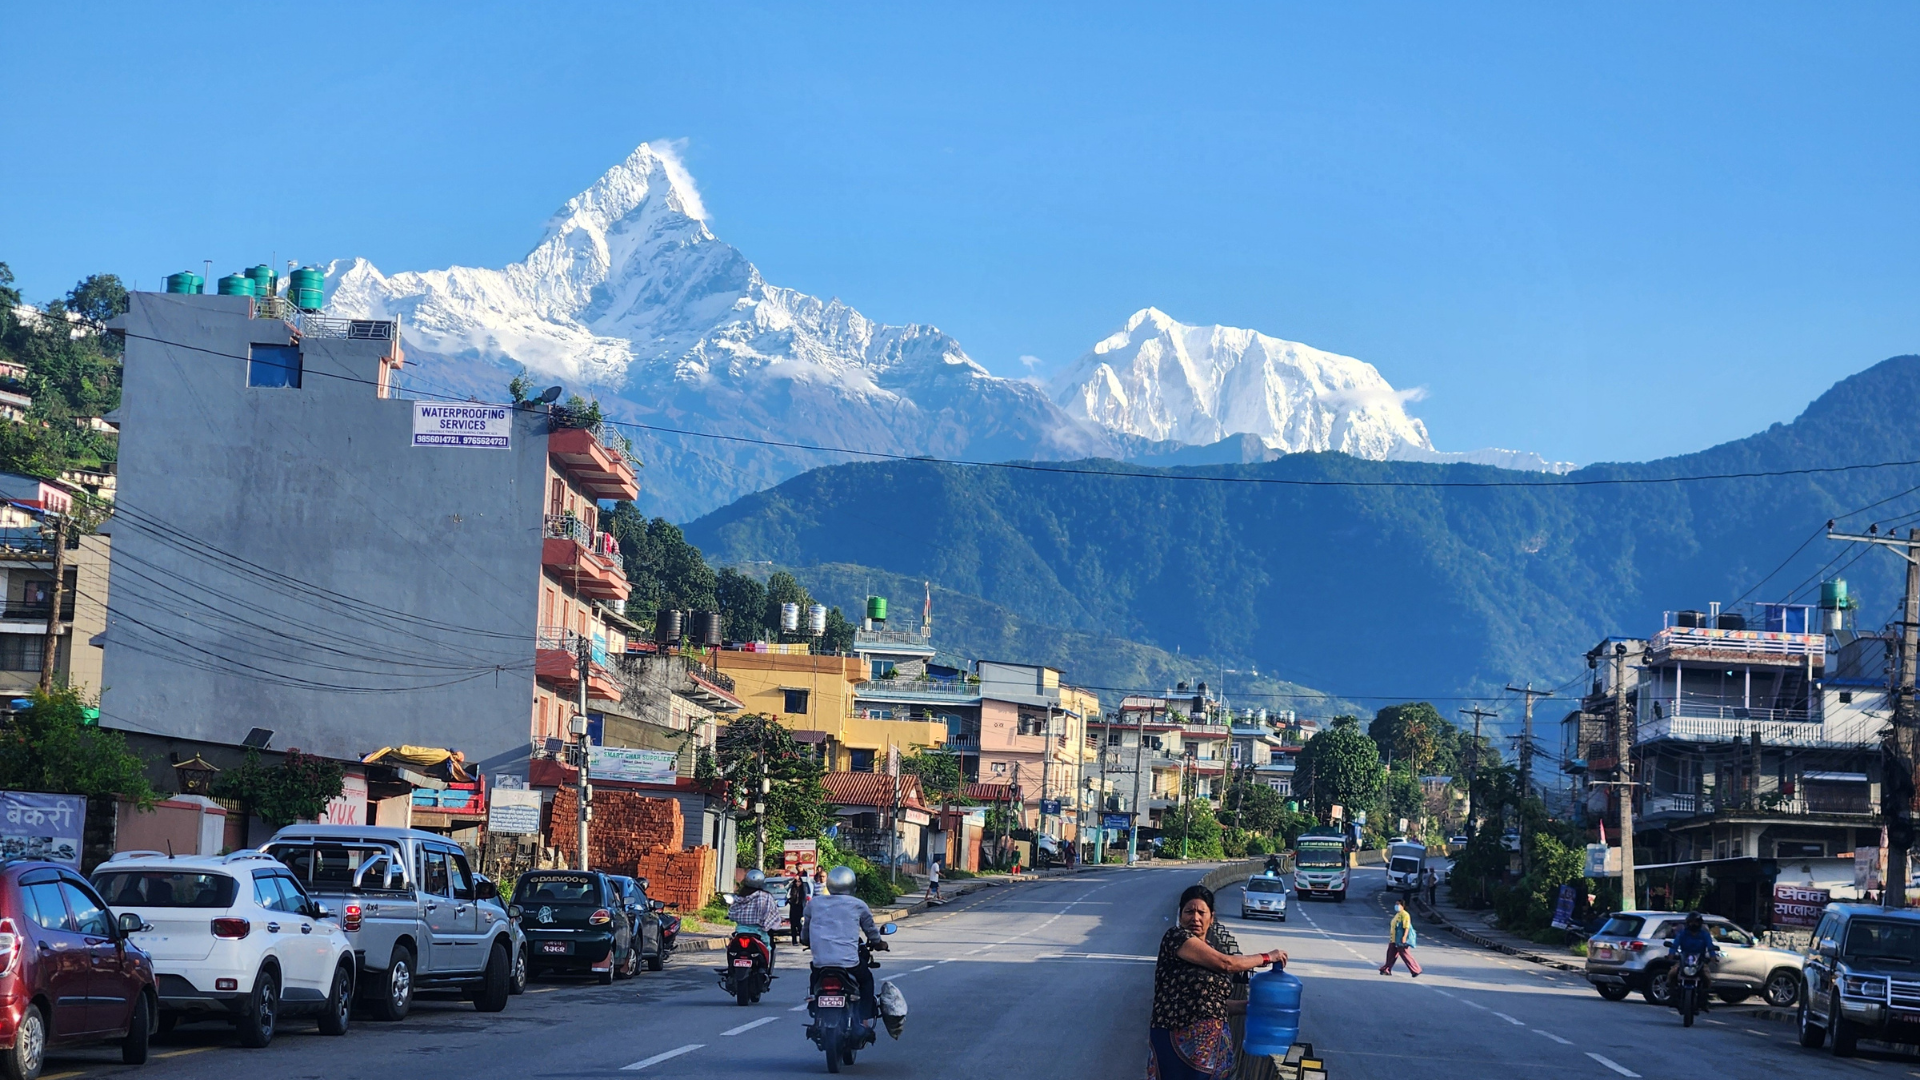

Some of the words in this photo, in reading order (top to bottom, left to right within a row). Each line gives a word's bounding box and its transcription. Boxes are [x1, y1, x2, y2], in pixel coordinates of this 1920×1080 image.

[421, 407, 505, 420] WATERPROOFING
[439, 419, 486, 430] SERVICES
[6, 800, 74, 832] बेकरी
[1778, 886, 1828, 902] सेवक
